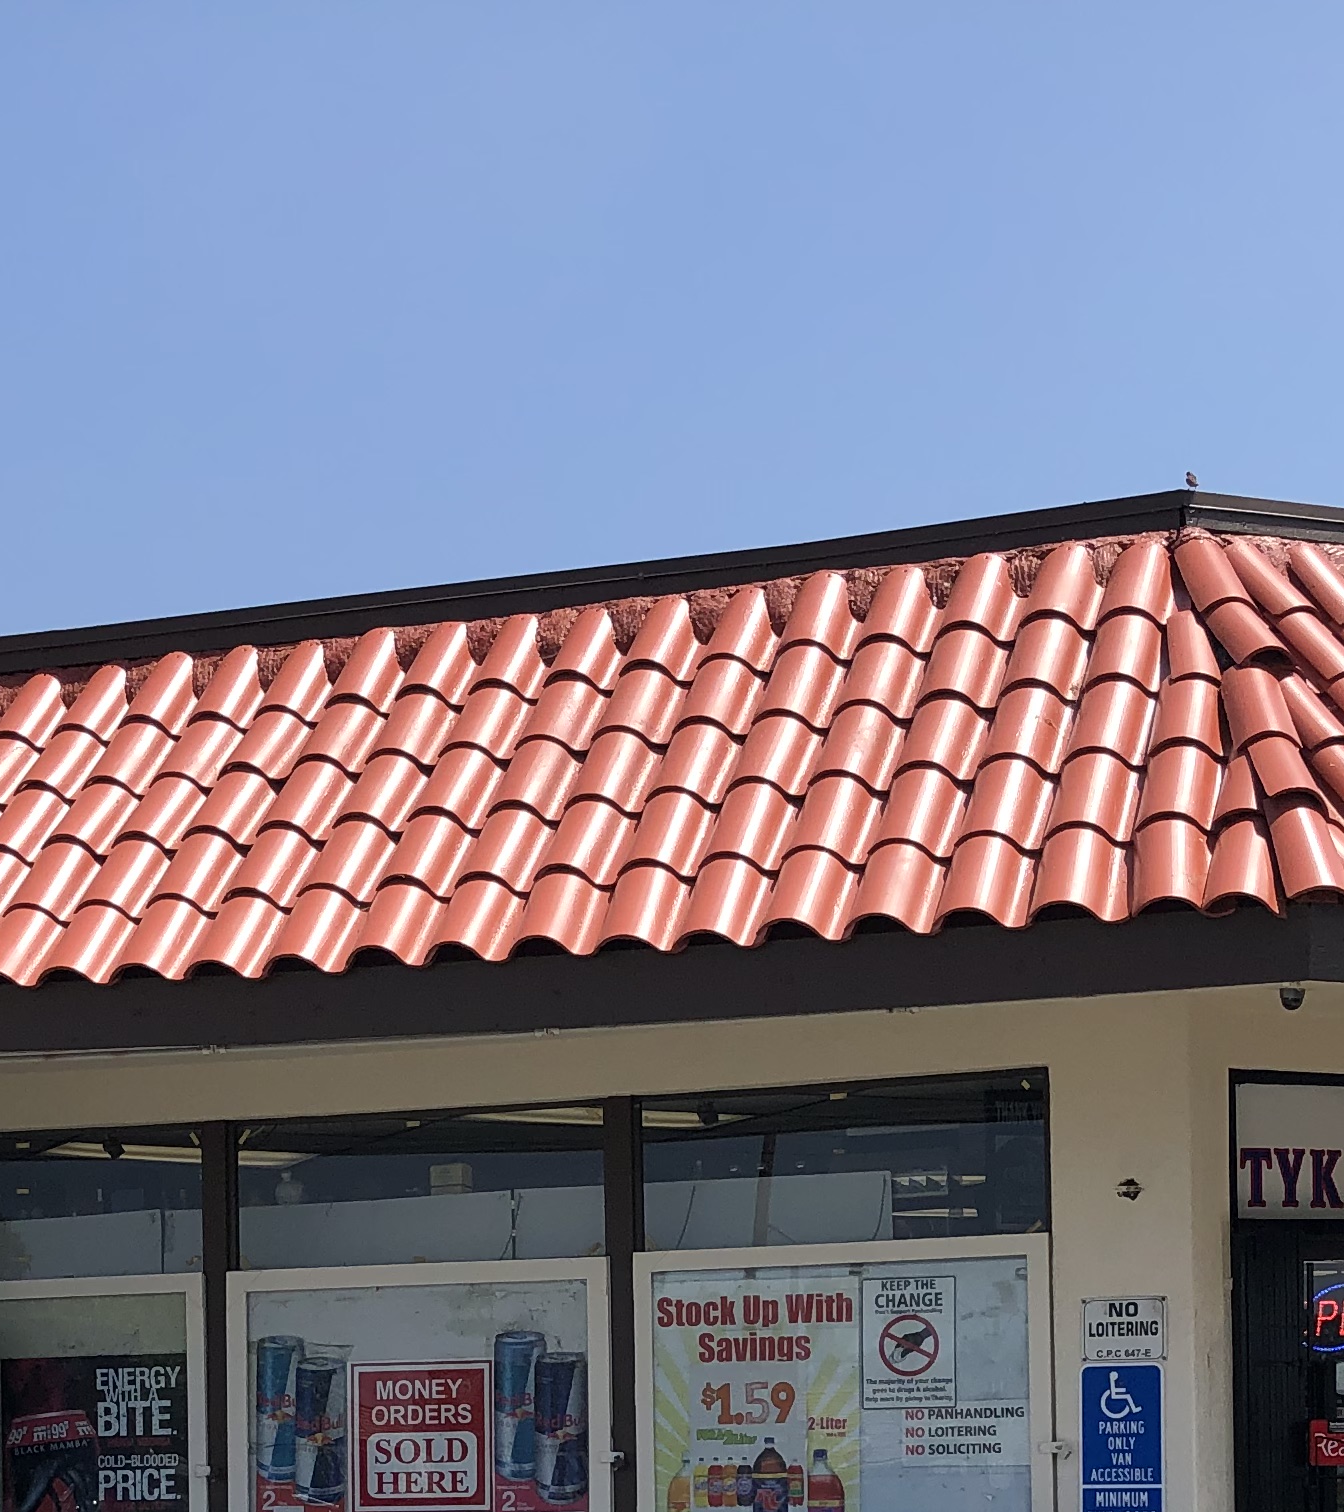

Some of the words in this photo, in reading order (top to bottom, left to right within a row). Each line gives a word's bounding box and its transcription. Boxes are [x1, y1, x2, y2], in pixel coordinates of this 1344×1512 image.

[881, 1280, 911, 1291] KEEP
[914, 1279, 936, 1290] THE
[875, 1292, 943, 1308] CHANGE
[657, 1296, 736, 1328] Stock
[743, 1295, 781, 1328] Up
[784, 1292, 853, 1324] With
[1108, 1302, 1139, 1318] NO
[1088, 1320, 1159, 1338] LOITERING
[698, 1332, 812, 1364] Savings
[96, 1366, 180, 1391] ENERGY
[104, 1388, 138, 1402] WITH
[376, 1379, 462, 1401] MONEY
[701, 1382, 796, 1425] $1.59
[97, 1400, 178, 1438] BITE.
[371, 1404, 472, 1426] ORDERS
[905, 1408, 924, 1420] NO
[928, 1406, 1025, 1420] PANHANDLING
[807, 1416, 847, 1430] 2-Liter
[905, 1426, 925, 1438] NO
[928, 1424, 997, 1438] LOITERING
[1099, 1421, 1145, 1435] PARKING
[14, 1445, 45, 1456] BLACK
[50, 1440, 90, 1452] MAMBA
[374, 1437, 469, 1465] SOLD
[905, 1444, 925, 1456] NO
[928, 1442, 1002, 1456] SOLICITING
[1108, 1437, 1136, 1450] ONLY
[98, 1454, 179, 1468] COLD-BLOODED
[1111, 1453, 1132, 1466] VAN
[374, 1471, 469, 1495] HERE
[1091, 1468, 1154, 1483] ACCESSIBLE
[99, 1469, 181, 1501] PRICE.
[1096, 1492, 1148, 1508] MINIMUM
